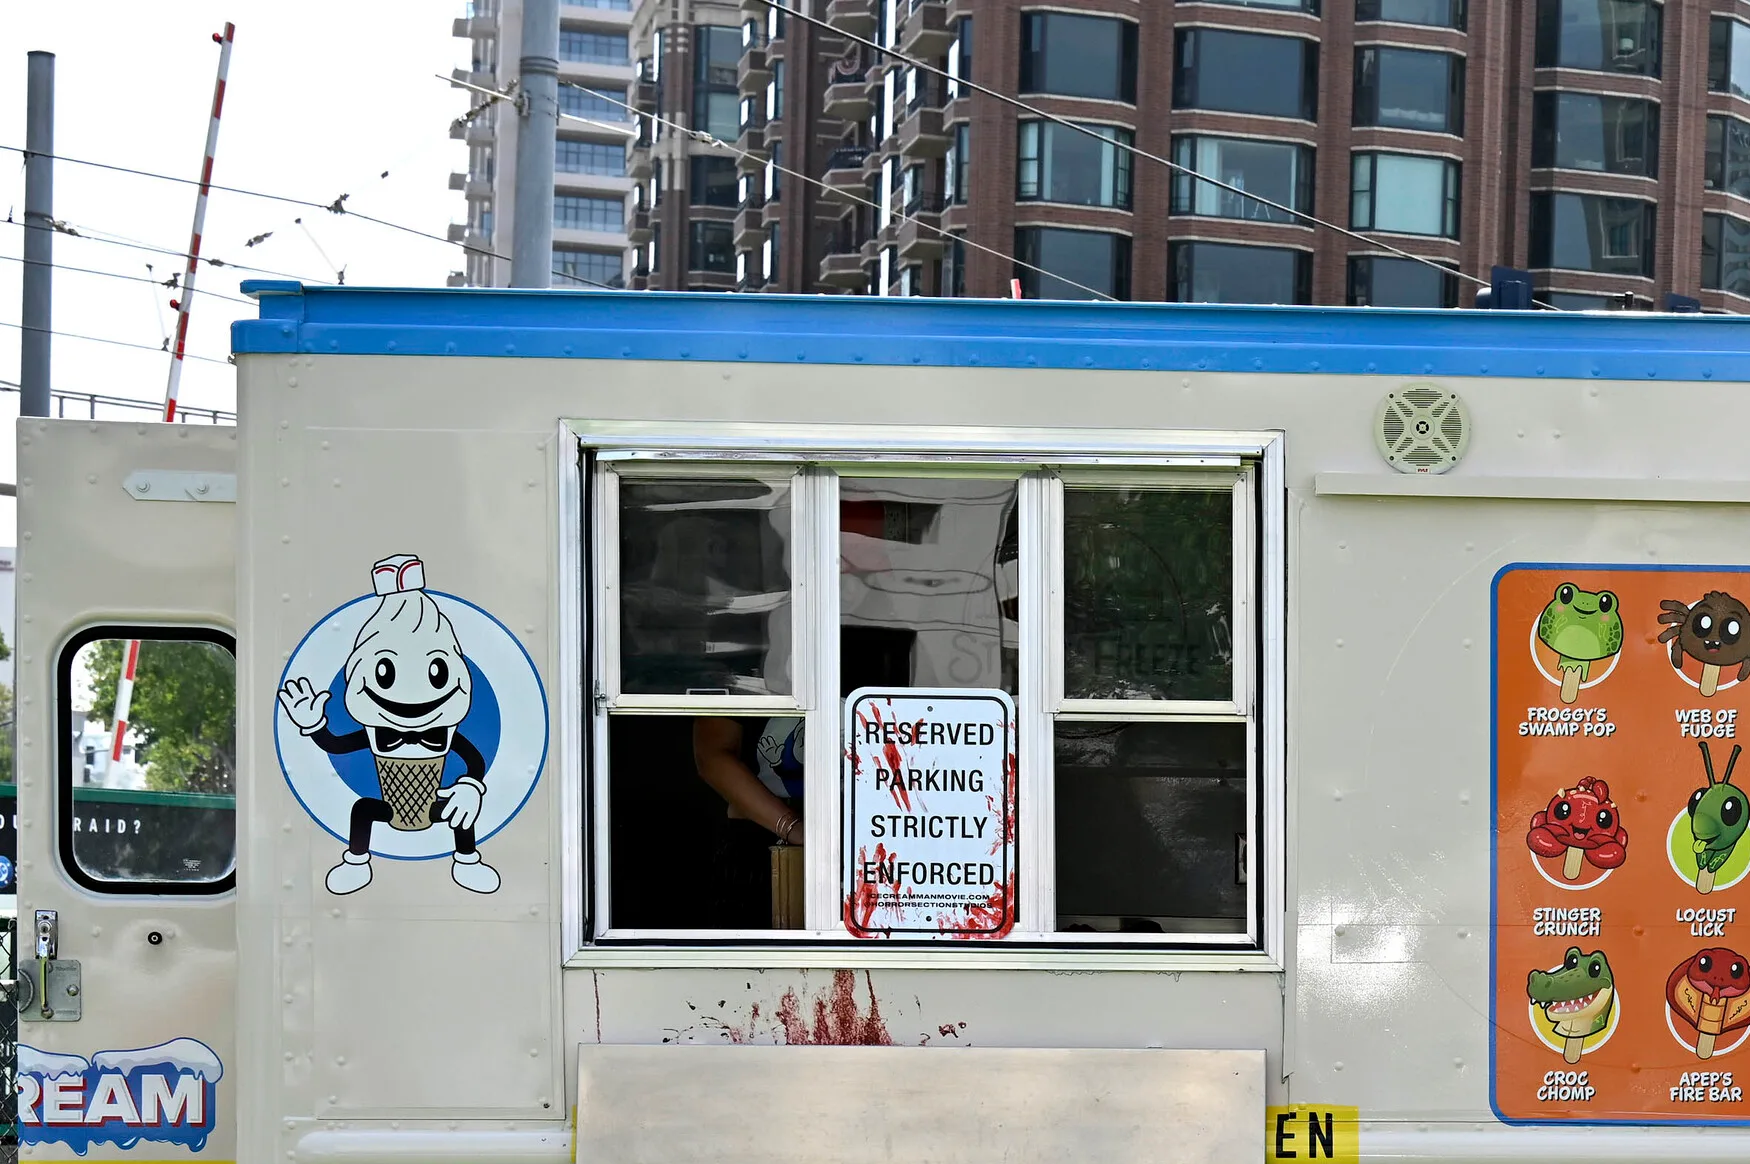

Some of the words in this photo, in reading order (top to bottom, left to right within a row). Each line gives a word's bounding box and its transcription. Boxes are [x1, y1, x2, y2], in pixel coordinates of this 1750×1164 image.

[1527, 706, 1608, 723] FROGGY'S
[1675, 709, 1712, 724] WEB
[1715, 709, 1738, 723] OF
[865, 722, 995, 746] RESERVED
[1518, 721, 1580, 738] SWAMP
[1583, 722, 1617, 738] POP
[1680, 723, 1737, 739] FUDGE
[875, 768, 985, 793] PARKING
[74, 818, 141, 834] RAID?
[871, 814, 988, 839] STRICTLY
[863, 861, 995, 886] ENFORCED
[1533, 907, 1602, 923] STINGER
[1676, 908, 1736, 923] LOCUST
[1534, 921, 1601, 937] CRUNCH
[1690, 922, 1725, 937] LICK
[1543, 1071, 1590, 1087] CROC
[1679, 1072, 1734, 1087] APEP'S
[1536, 1085, 1596, 1102] CHOMP
[1670, 1087, 1706, 1102] FIRE
[1708, 1087, 1743, 1102] BAR
[1276, 1112, 1333, 1158] EN
